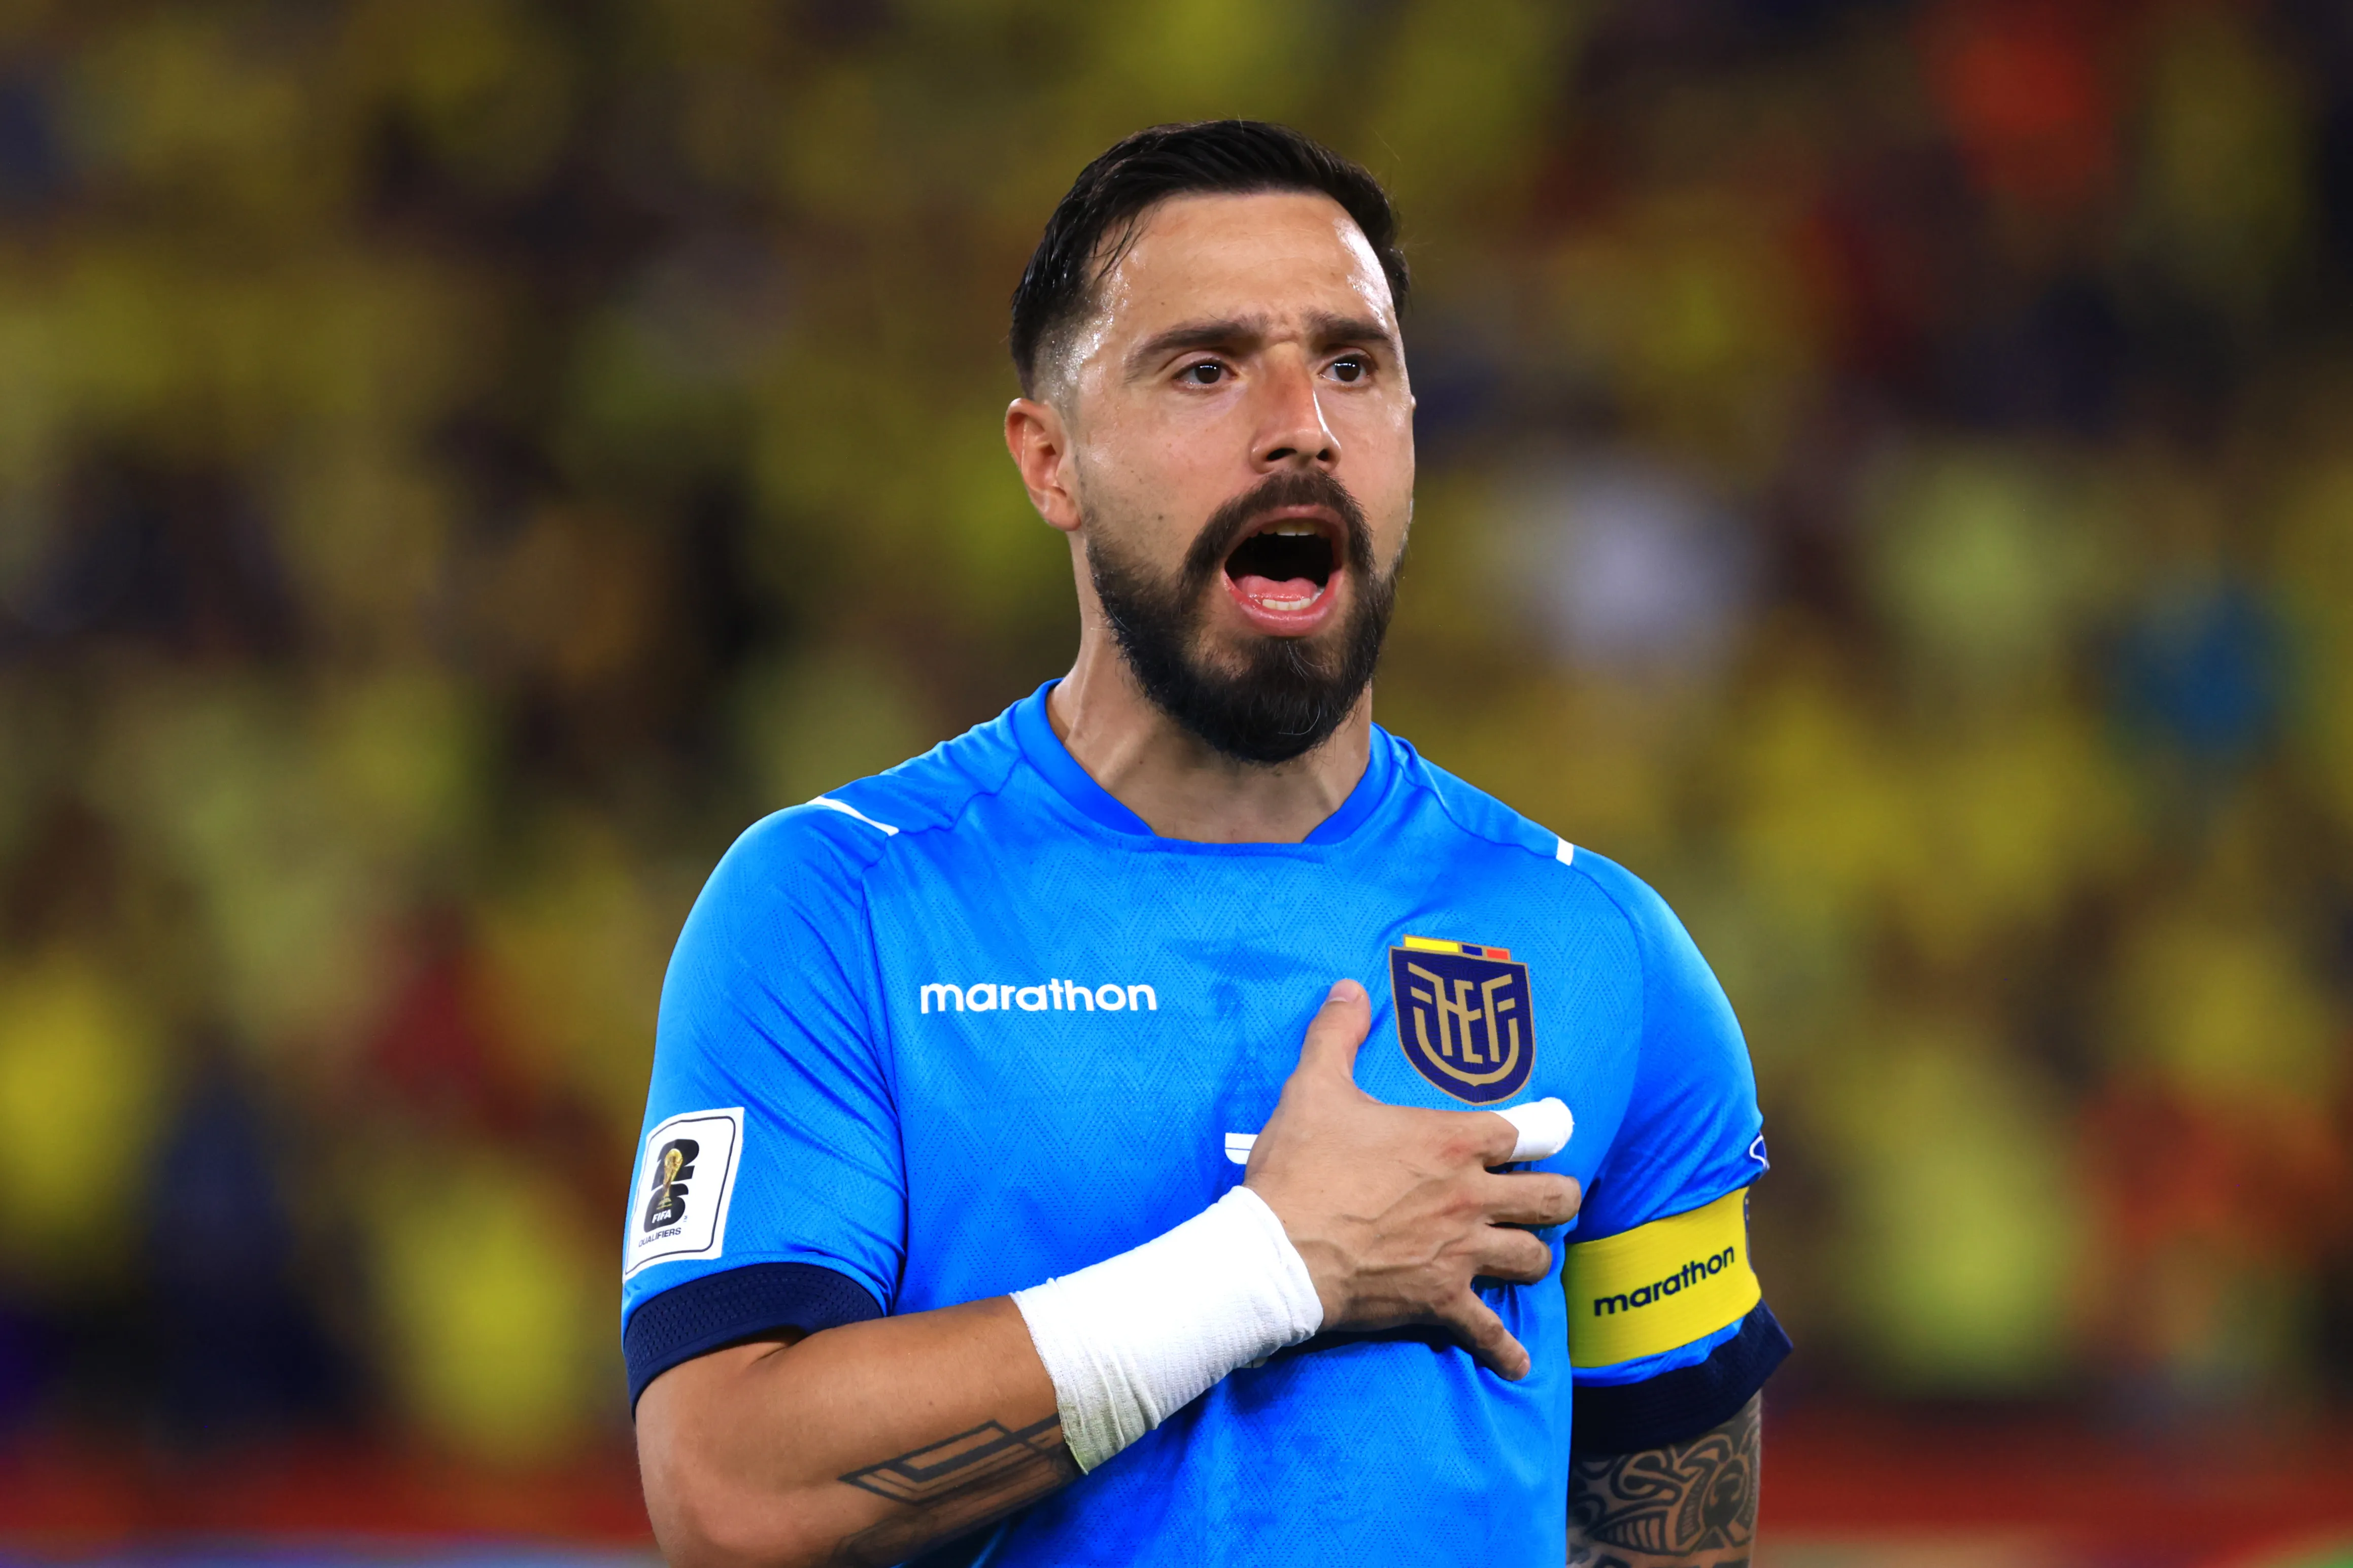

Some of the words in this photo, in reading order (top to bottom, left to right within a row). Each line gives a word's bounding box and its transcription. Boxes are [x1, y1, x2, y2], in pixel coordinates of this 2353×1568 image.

[920, 978, 1157, 1014] marathon
[652, 1209, 671, 1224] FIFA
[638, 1227, 681, 1247] QUALIFIERS
[1594, 1246, 1735, 1317] marathon
